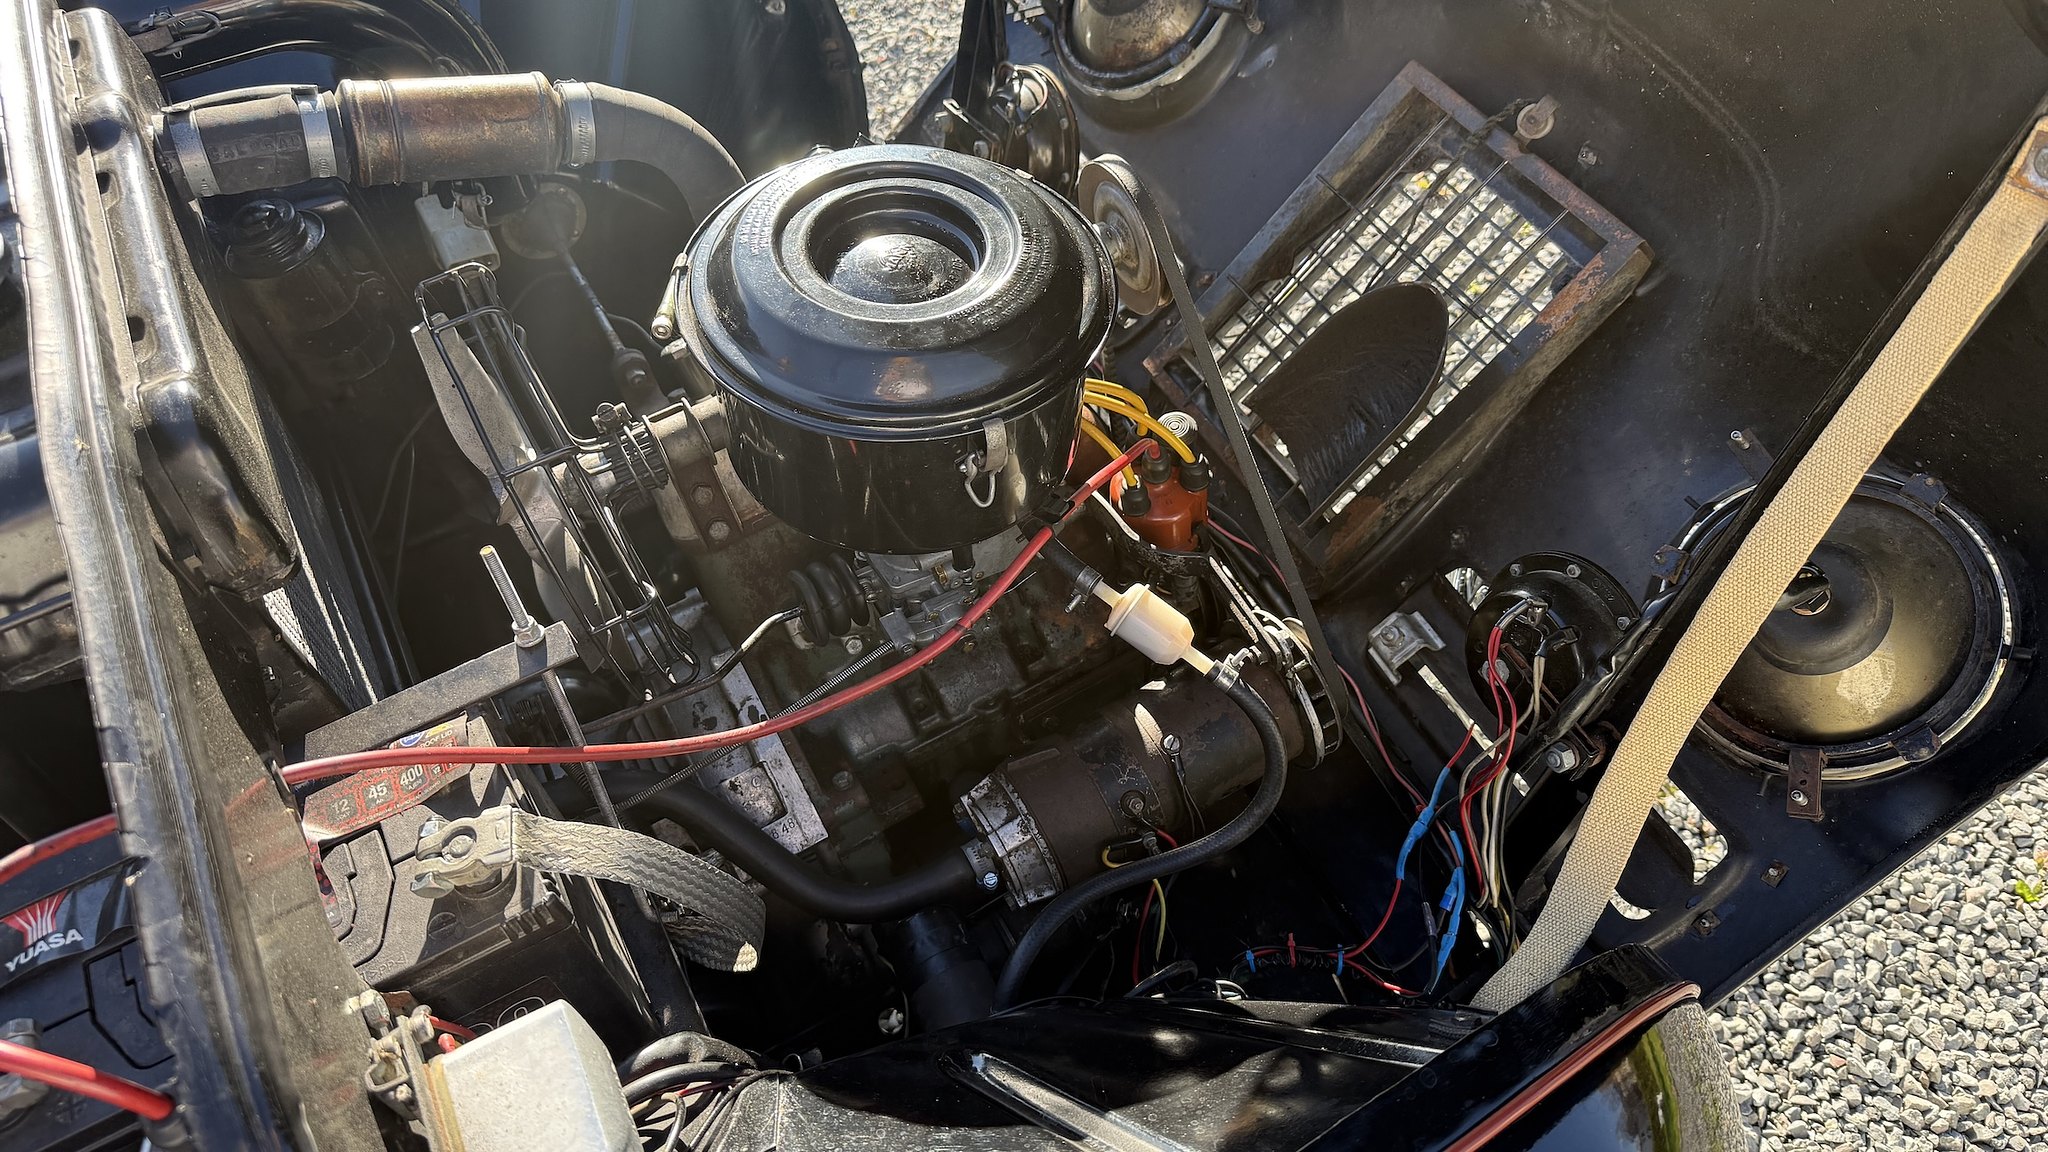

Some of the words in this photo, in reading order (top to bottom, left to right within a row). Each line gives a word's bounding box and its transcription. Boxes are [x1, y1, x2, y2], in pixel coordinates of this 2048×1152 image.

[400, 763, 423, 786] 400
[368, 781, 388, 799] 45
[332, 799, 350, 814] 12
[4, 928, 84, 972] YUASA
